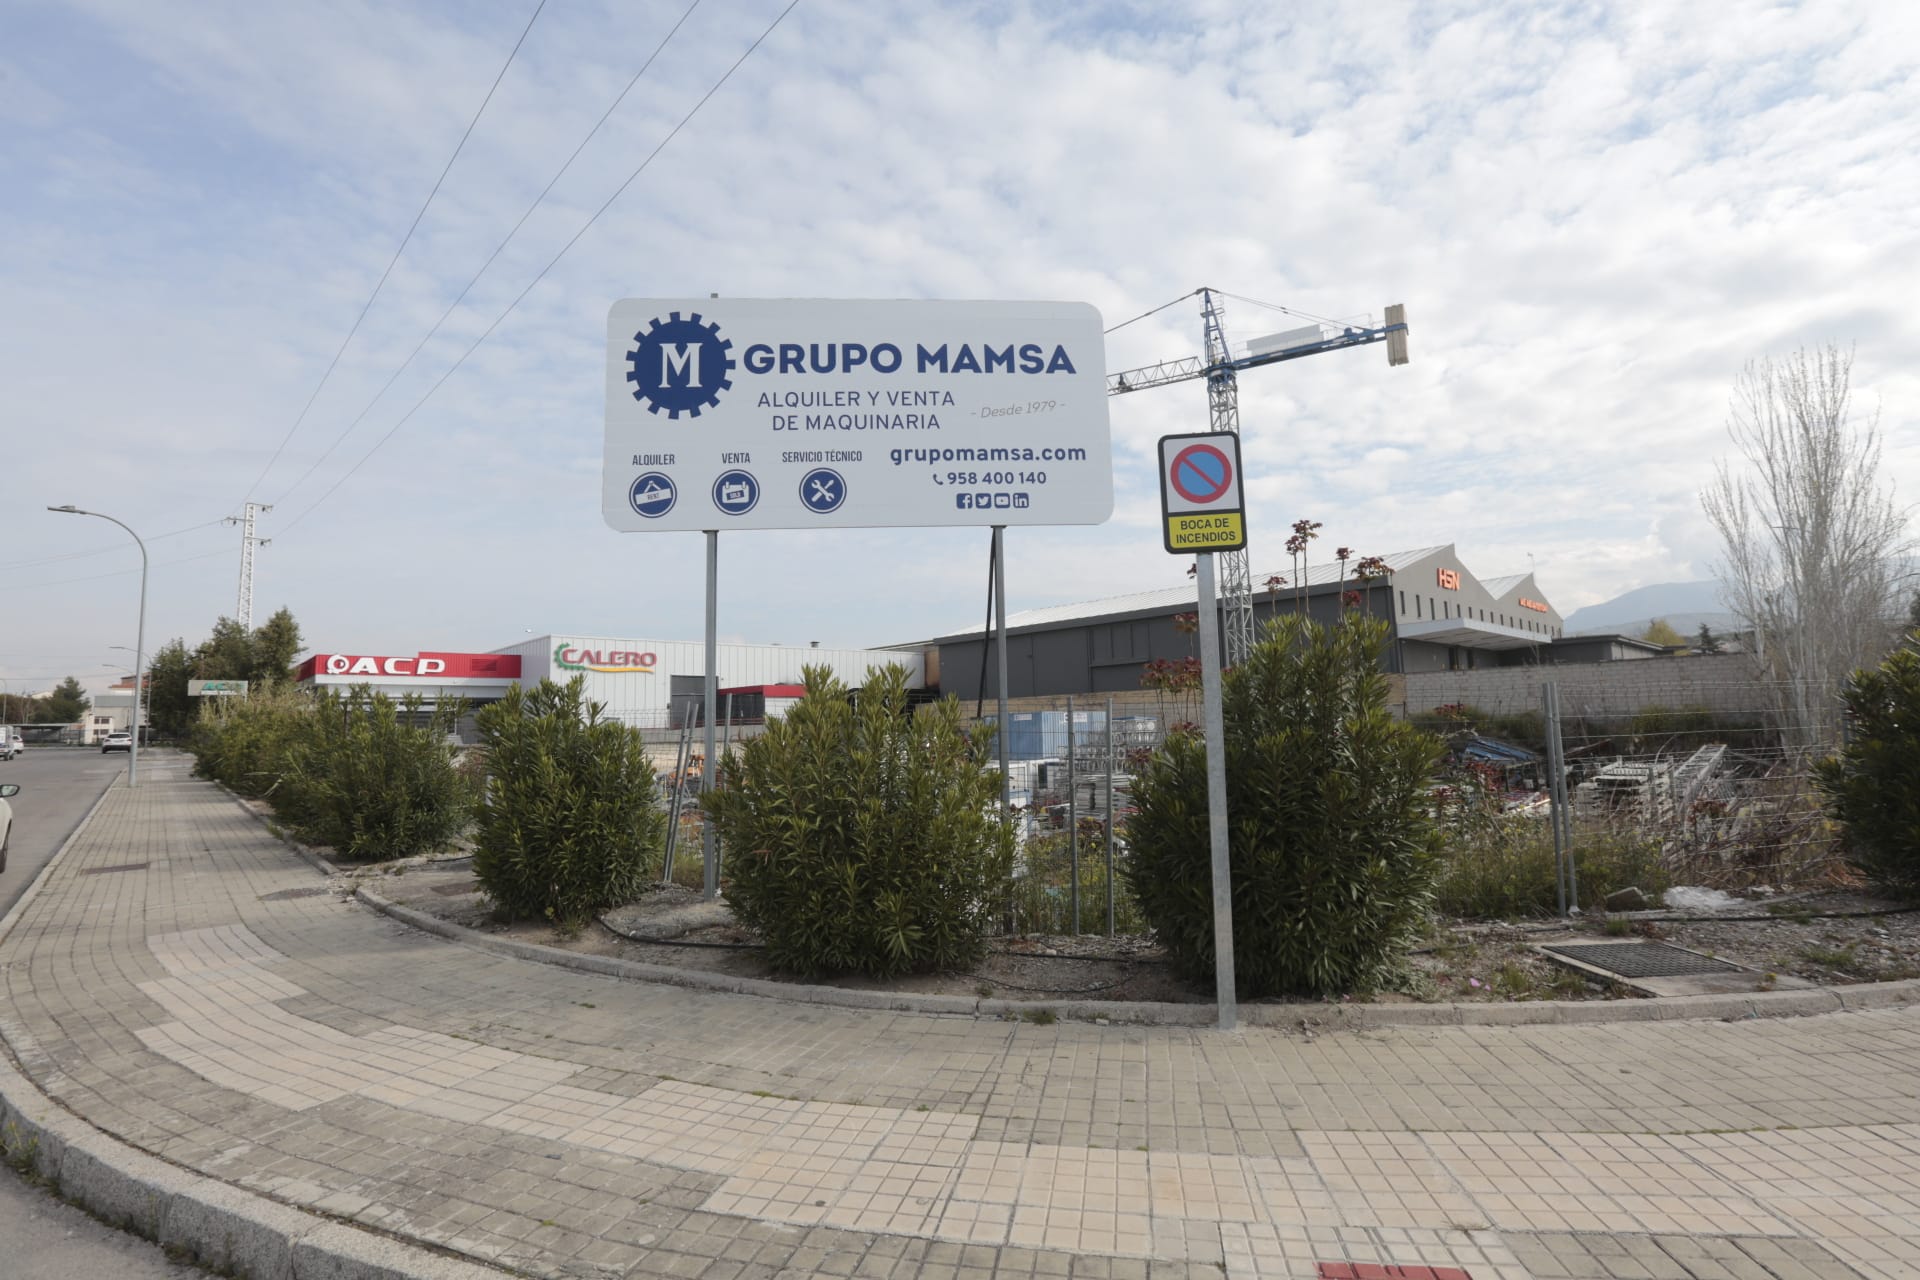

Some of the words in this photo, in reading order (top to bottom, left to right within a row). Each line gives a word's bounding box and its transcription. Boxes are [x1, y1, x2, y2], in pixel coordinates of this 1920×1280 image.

[659, 343, 702, 387] M
[744, 343, 902, 374] GRUPO
[917, 344, 1077, 374] MAMSA
[758, 391, 860, 408] ALQUILER
[868, 391, 880, 406] Y
[887, 391, 955, 406] VENTA
[981, 404, 1022, 418] Desde
[1026, 400, 1056, 413] 1979
[773, 415, 798, 431] DE
[806, 414, 940, 430] MAQUINARIA
[632, 454, 675, 465] ALQUILER
[722, 453, 750, 464] VENTA
[782, 451, 822, 462] SERVICIO
[825, 449, 862, 462] TÉCNICO
[890, 448, 1086, 466] grupomamsa.com
[947, 472, 977, 485] 958
[982, 472, 1014, 484] 400
[1019, 472, 1046, 484] 140
[1180, 519, 1212, 530] BOCA
[1215, 518, 1229, 528] DE
[1176, 531, 1236, 543] INCENDIOS
[562, 649, 657, 666] CALERO
